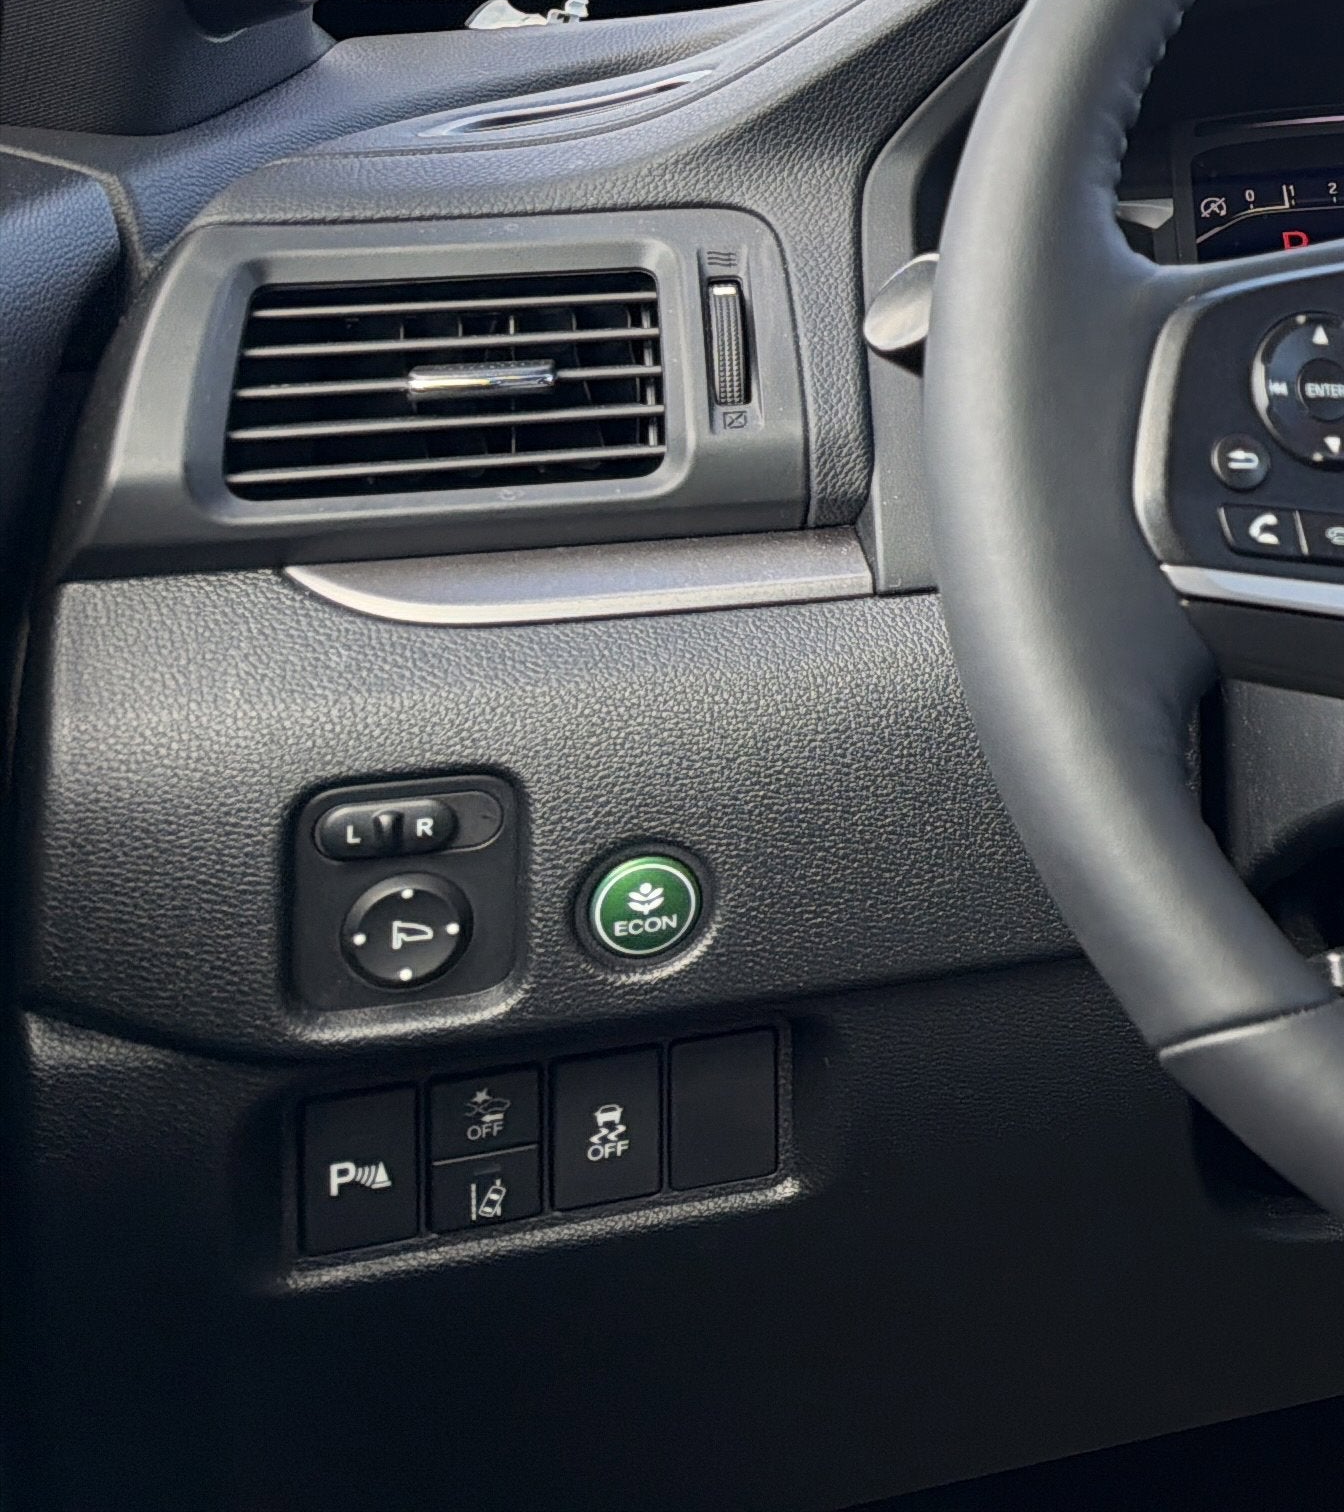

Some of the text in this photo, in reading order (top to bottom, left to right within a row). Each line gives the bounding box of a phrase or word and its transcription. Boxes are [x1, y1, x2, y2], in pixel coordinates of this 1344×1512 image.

[1245, 189, 1255, 201] 0
[1328, 182, 1338, 194] 2
[346, 818, 434, 844] L R
[613, 912, 678, 936] ECON
[466, 1121, 505, 1141] OFF
[587, 1139, 630, 1162] OFF
